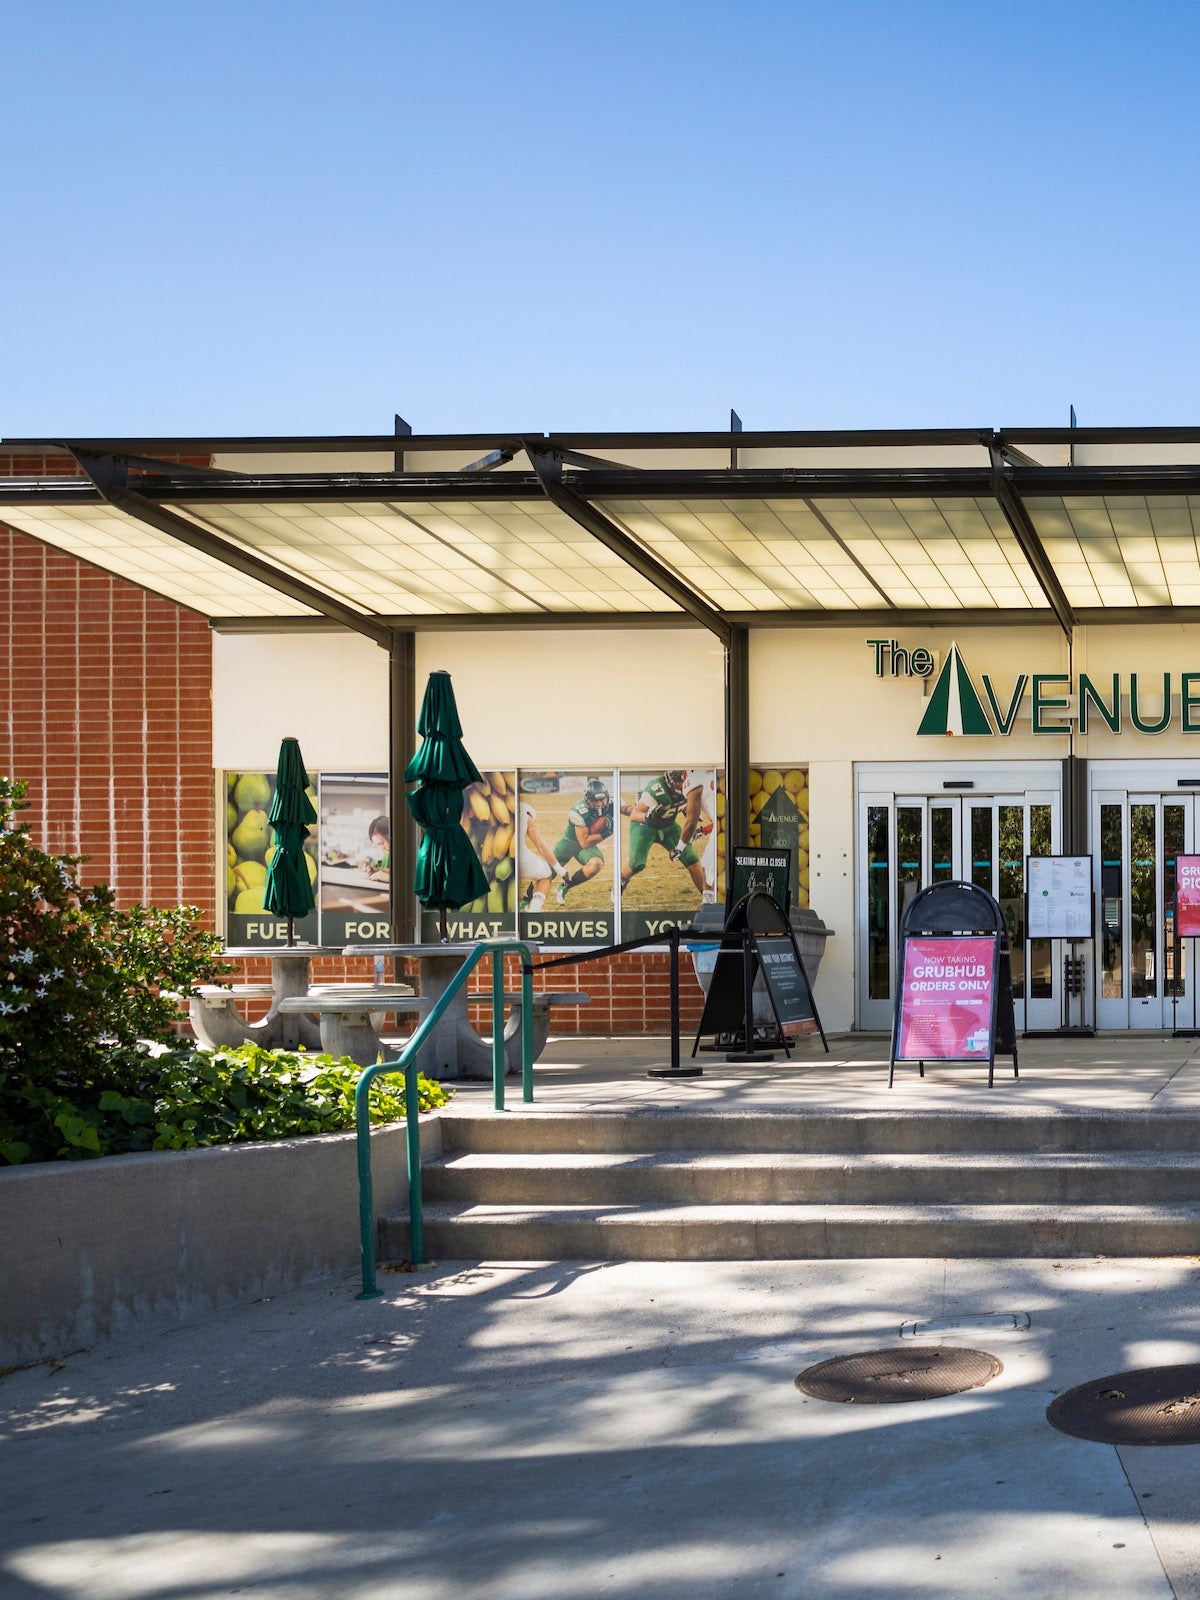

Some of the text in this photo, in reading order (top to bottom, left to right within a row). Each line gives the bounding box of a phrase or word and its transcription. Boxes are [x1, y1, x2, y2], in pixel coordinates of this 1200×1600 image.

[866, 639, 934, 679] The
[246, 922, 301, 940] FUEL
[345, 922, 390, 938] FOR
[435, 921, 503, 939] WHAT
[527, 921, 609, 938] DRIVES
[924, 956, 945, 964] NOW
[913, 965, 986, 978] GRUBHUB
[910, 980, 990, 991] ORDERS ONLY
